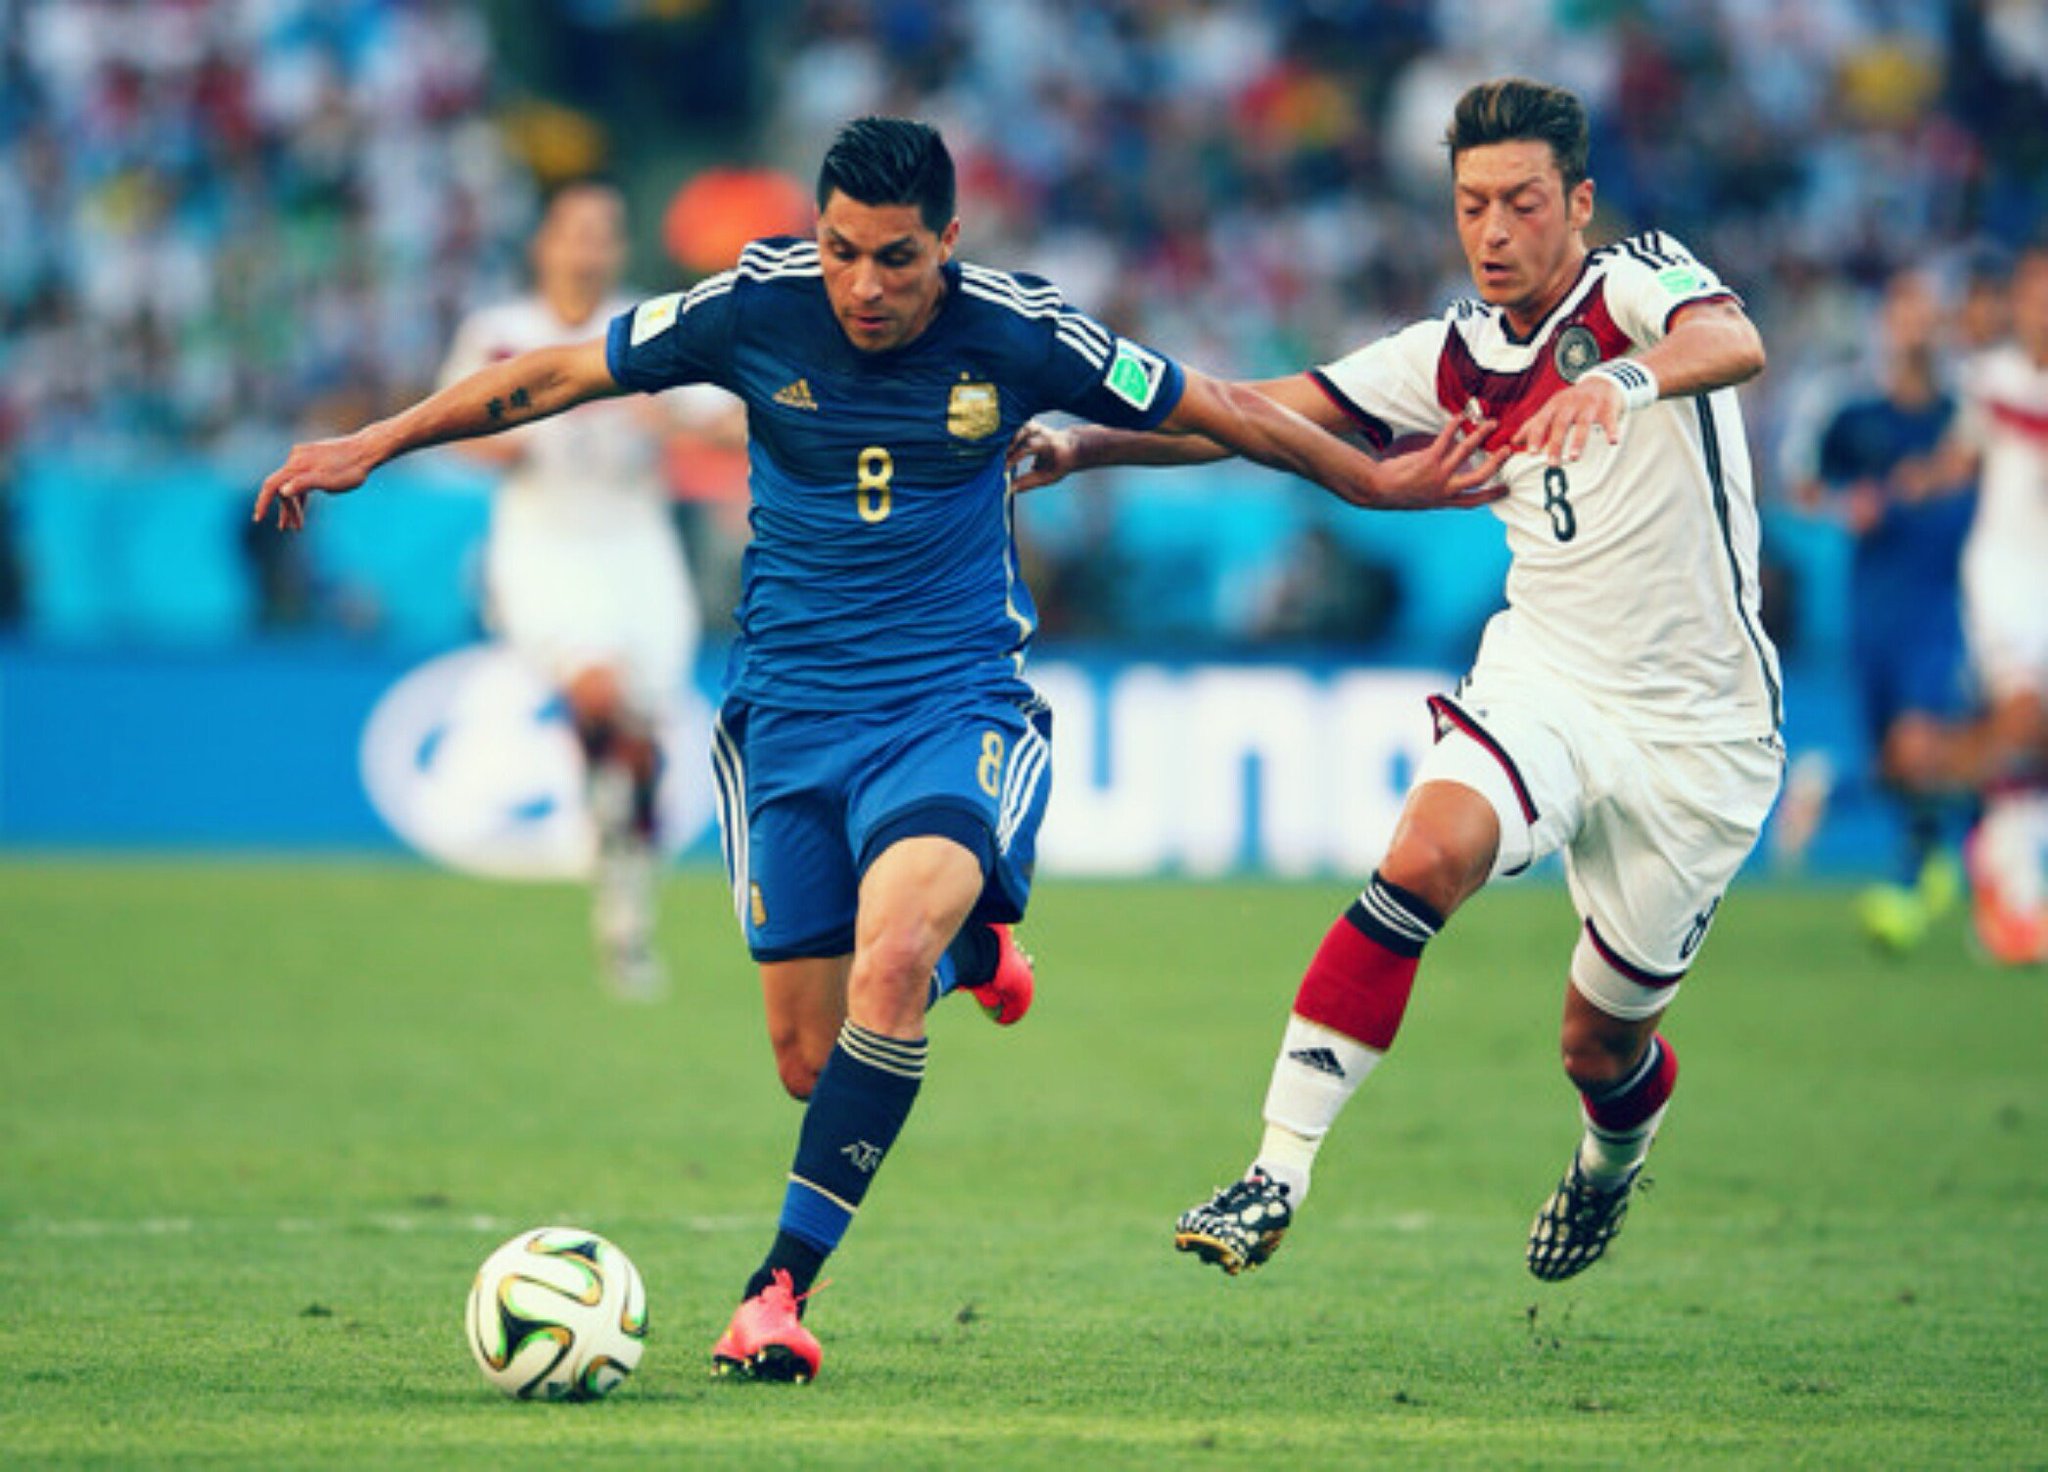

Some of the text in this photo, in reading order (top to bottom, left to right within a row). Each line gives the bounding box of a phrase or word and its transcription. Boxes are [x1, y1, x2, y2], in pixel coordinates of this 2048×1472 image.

[857, 445, 893, 523] 8
[1544, 466, 1577, 542] 8
[977, 730, 1004, 797] 8
